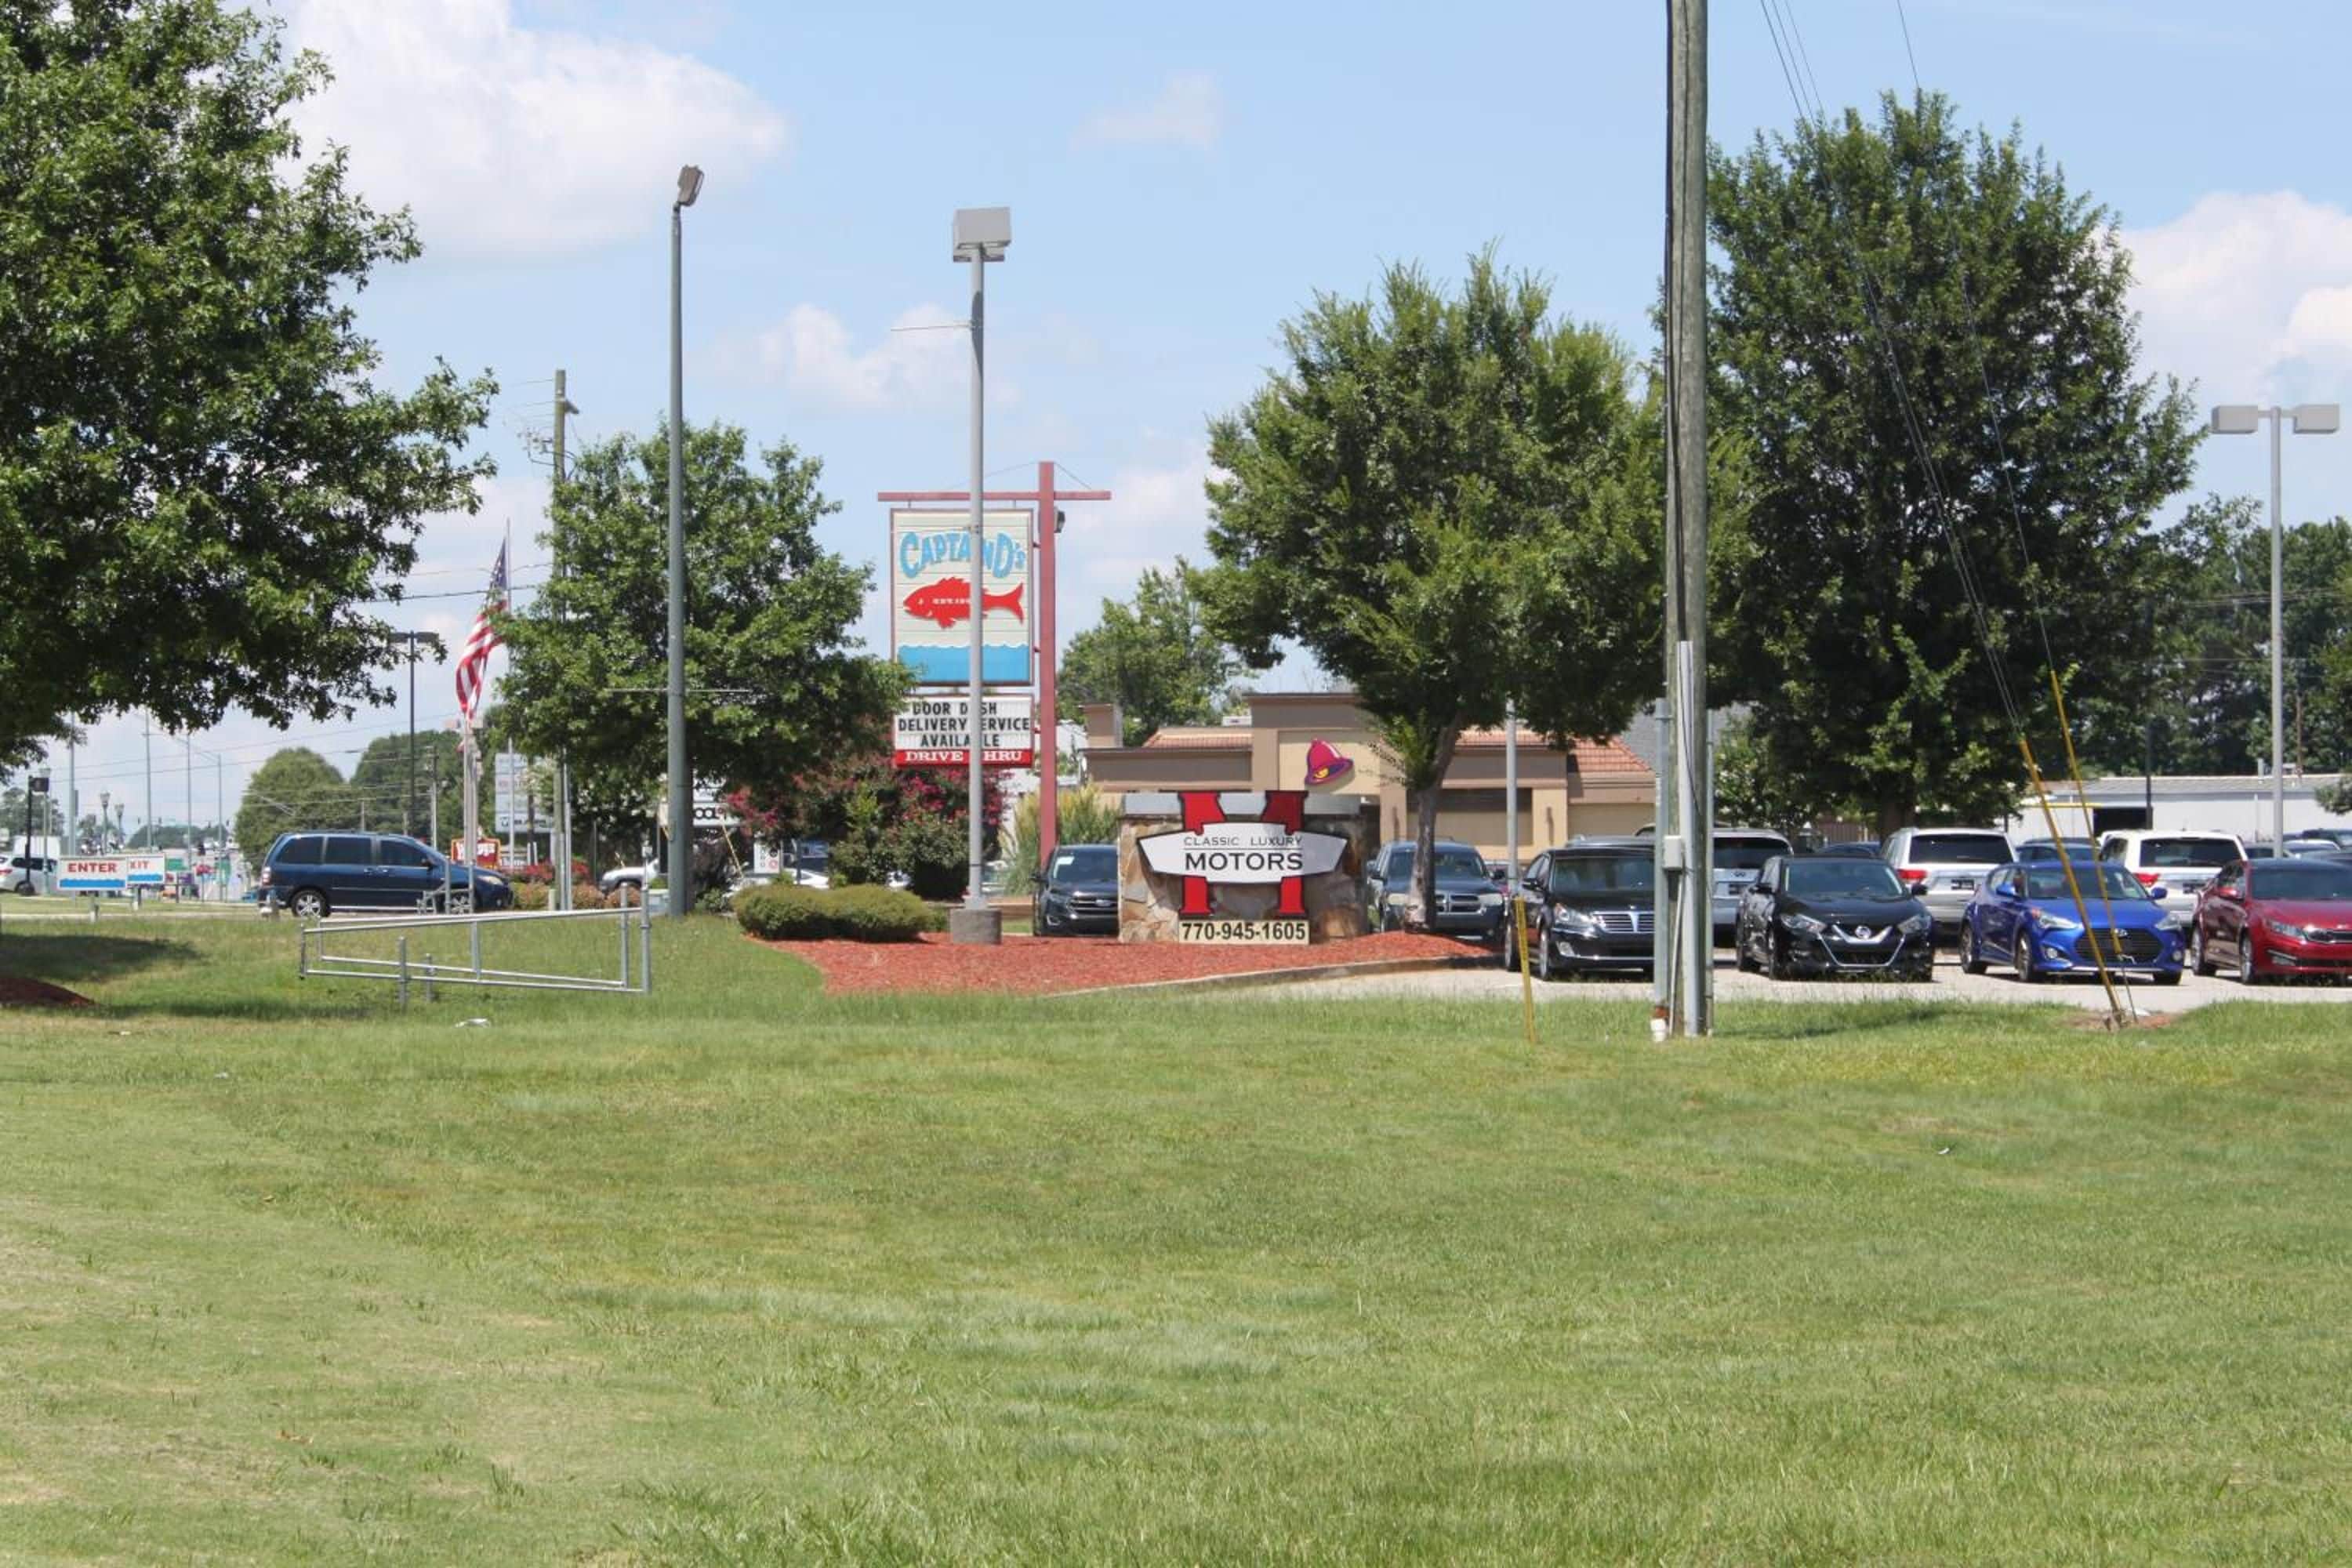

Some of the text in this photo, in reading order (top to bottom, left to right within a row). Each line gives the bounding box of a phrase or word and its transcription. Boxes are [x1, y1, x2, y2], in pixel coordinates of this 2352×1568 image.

[900, 532, 994, 579] CAPTAN
[913, 702, 996, 716] DOOR DSH
[898, 718, 1029, 731] DELIVERY ERVICE
[920, 735, 1000, 747] AVAILALE
[905, 751, 1022, 761] DRIVE HRU
[1184, 837, 1302, 846] CLASSIC LUXURY
[67, 862, 117, 873] ENTER
[1185, 852, 1303, 871] MOTORS
[1181, 922, 1305, 940] 770-945-1605
